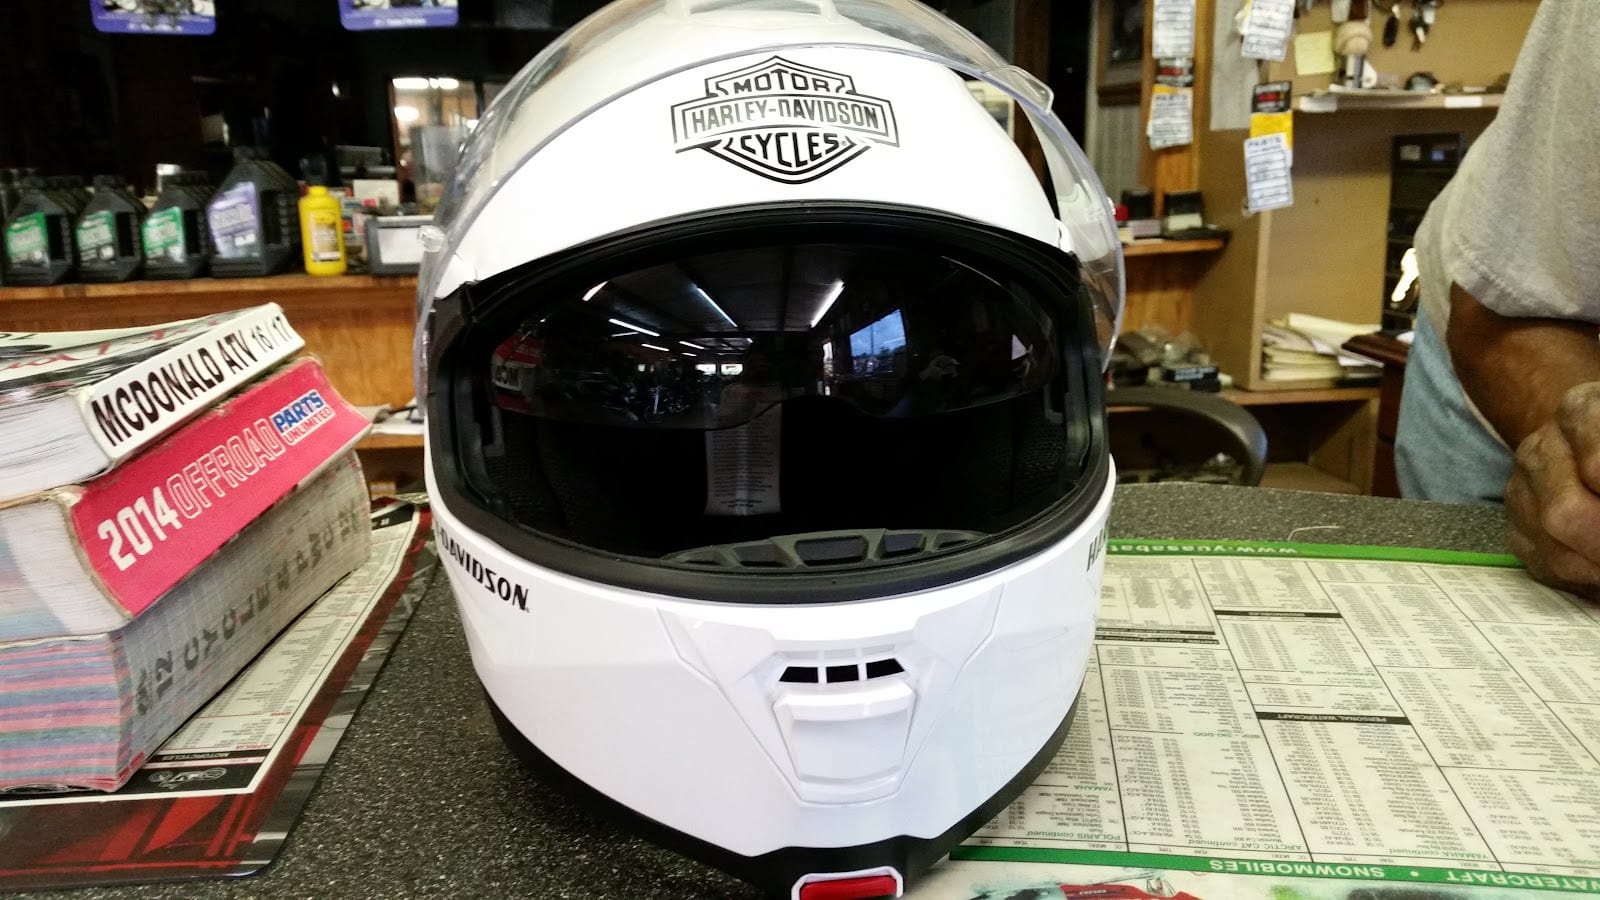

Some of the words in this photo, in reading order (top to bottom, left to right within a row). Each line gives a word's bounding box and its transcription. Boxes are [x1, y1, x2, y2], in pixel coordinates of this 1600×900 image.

[733, 68, 831, 95] MOTOR
[691, 98, 879, 135] HARLEY-DAVIDSON
[740, 131, 840, 169] CYCLES
[91, 346, 225, 447] MCDONALD
[217, 329, 259, 375] ATV
[250, 325, 275, 353] 16
[272, 315, 293, 342] 17
[273, 388, 325, 435] PARTS
[282, 405, 335, 446] UNLIMITED
[97, 485, 183, 572] 2014
[166, 417, 286, 520] OFFROAD
[435, 521, 530, 612] -DAVIDSON
[162, 752, 230, 761] MOTORCYCLES
[1077, 832, 1121, 840] POLARIS
[1188, 839, 1238, 847] continued
[1263, 843, 1302, 851] ARCTIC
[1388, 848, 1440, 856] continued
[1208, 860, 1385, 878] SNOWMOBILES
